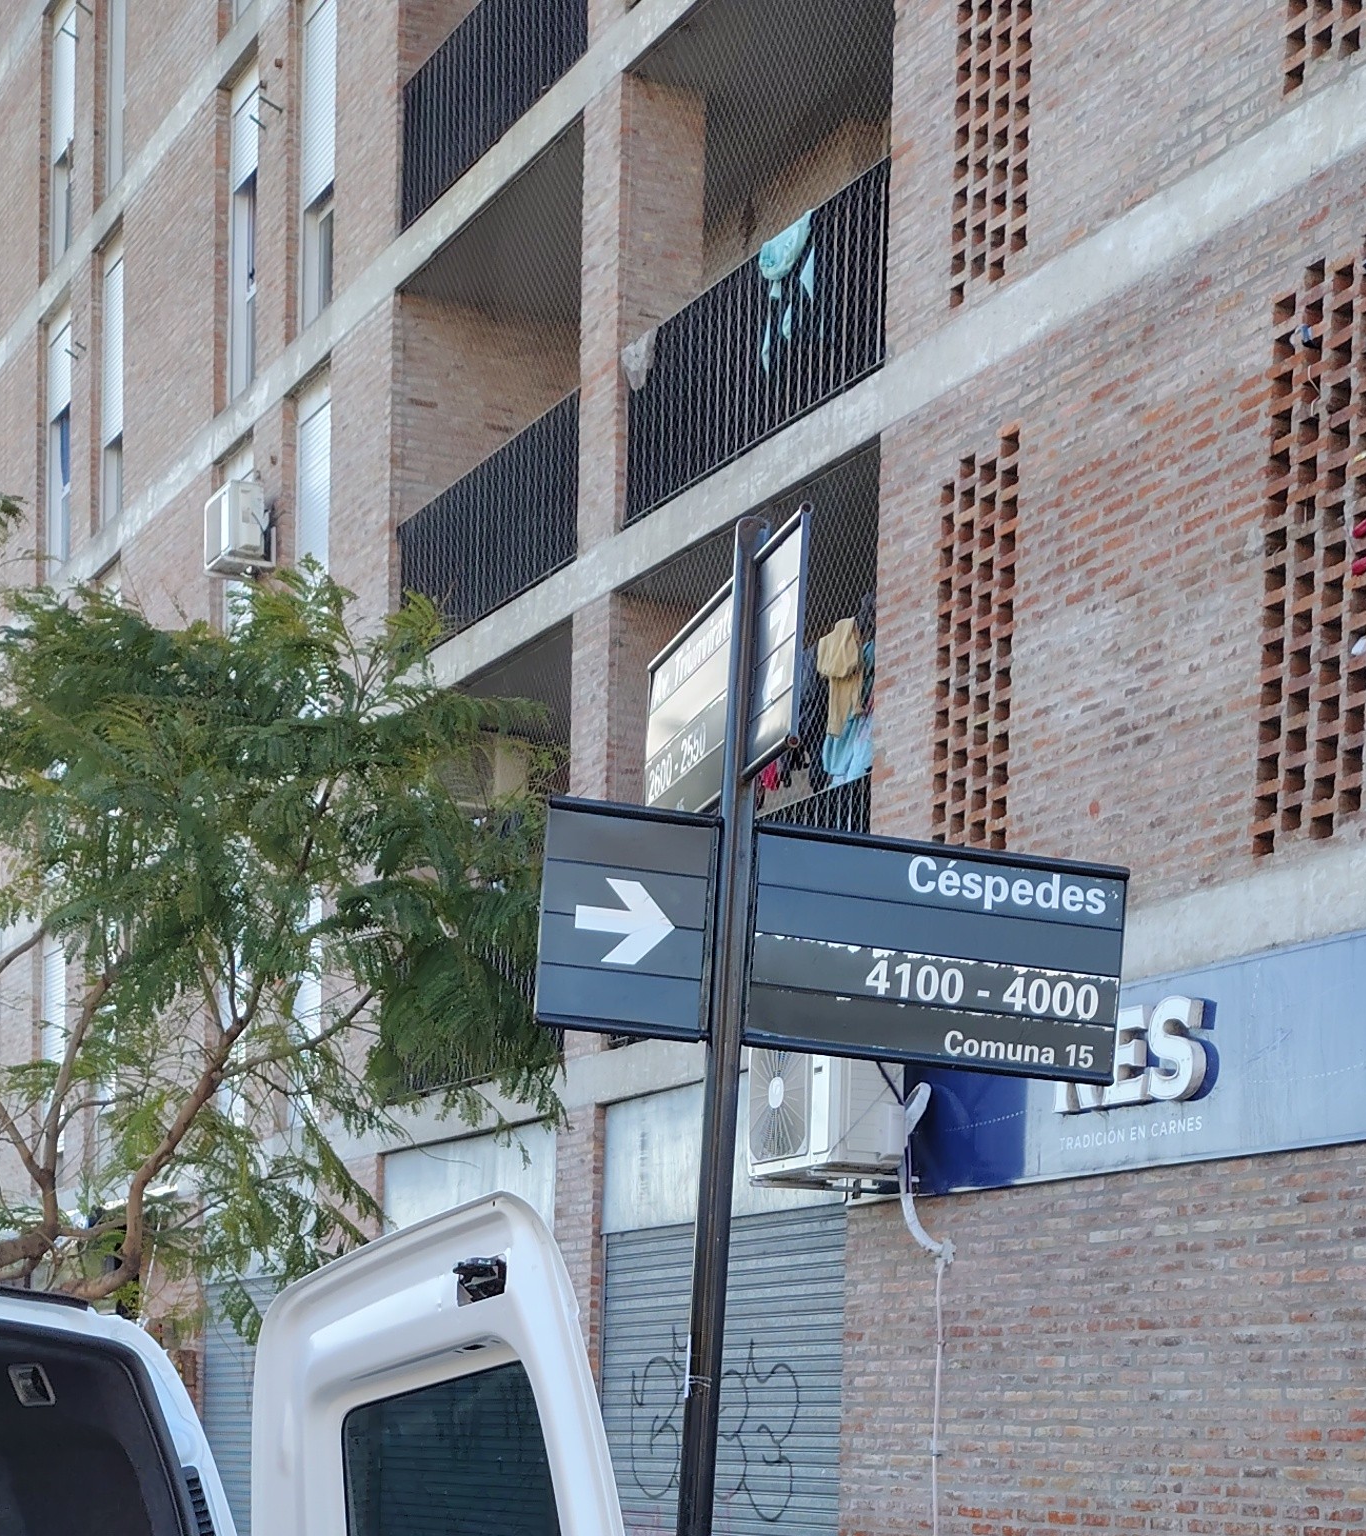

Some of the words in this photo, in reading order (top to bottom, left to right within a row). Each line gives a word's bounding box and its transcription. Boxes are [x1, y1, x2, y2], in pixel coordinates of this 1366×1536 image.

[651, 671, 671, 709] Av.
[648, 753, 673, 800] 2600
[679, 722, 707, 772] 2550
[908, 856, 1107, 915] Céspedes
[865, 960, 964, 1003] 4100
[976, 988, 991, 998] -
[1002, 976, 1099, 1020] 4000
[944, 1030, 1056, 1065] Comuna
[1064, 1044, 1094, 1069] 15
[1059, 1124, 1125, 1151] TRADICIÓN
[1129, 1126, 1147, 1139] EN
[1150, 1115, 1203, 1138] CARNES
